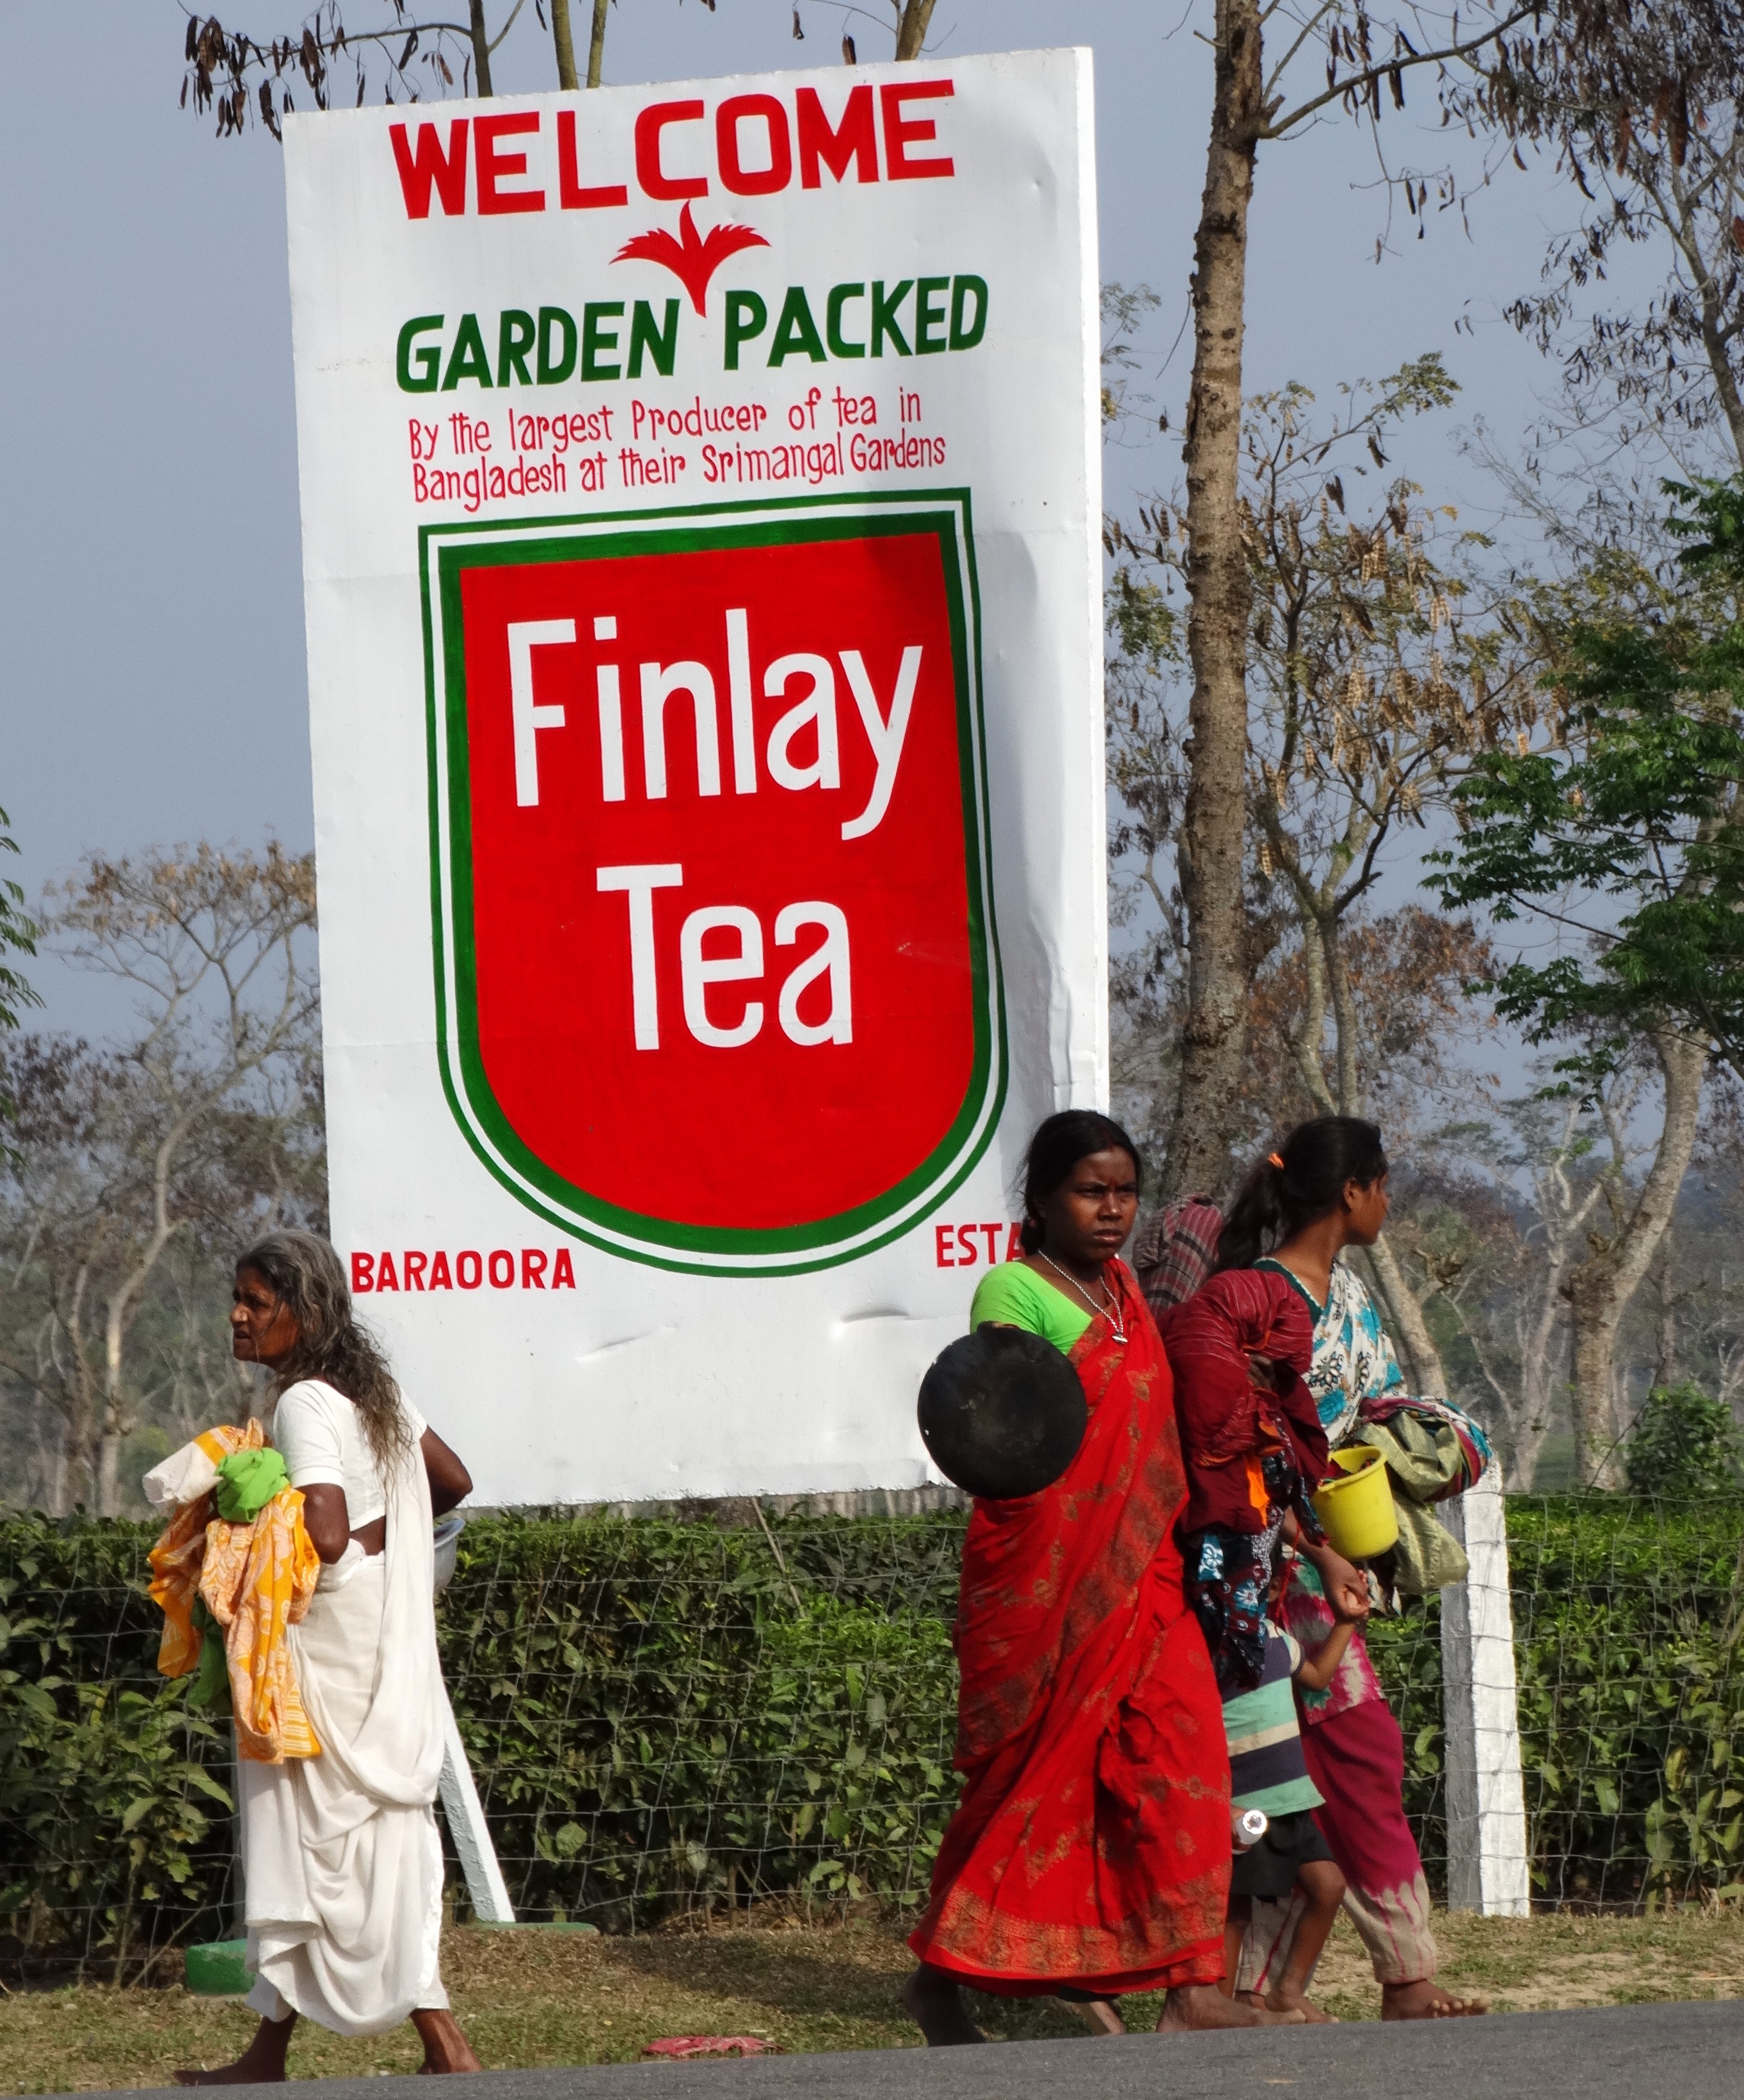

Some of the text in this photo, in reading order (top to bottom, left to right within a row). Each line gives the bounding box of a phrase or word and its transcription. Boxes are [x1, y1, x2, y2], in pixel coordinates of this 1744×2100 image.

[388, 78, 956, 220] WELCOME
[396, 274, 989, 393] GARDEN PACKED
[408, 385, 922, 461] By the largest Producer of tea in
[412, 427, 947, 513] Bangladesh at their Srimangal Gardens
[506, 608, 924, 841] Finlay
[595, 863, 854, 1051] Tea
[350, 1247, 577, 1294] BARAOORA
